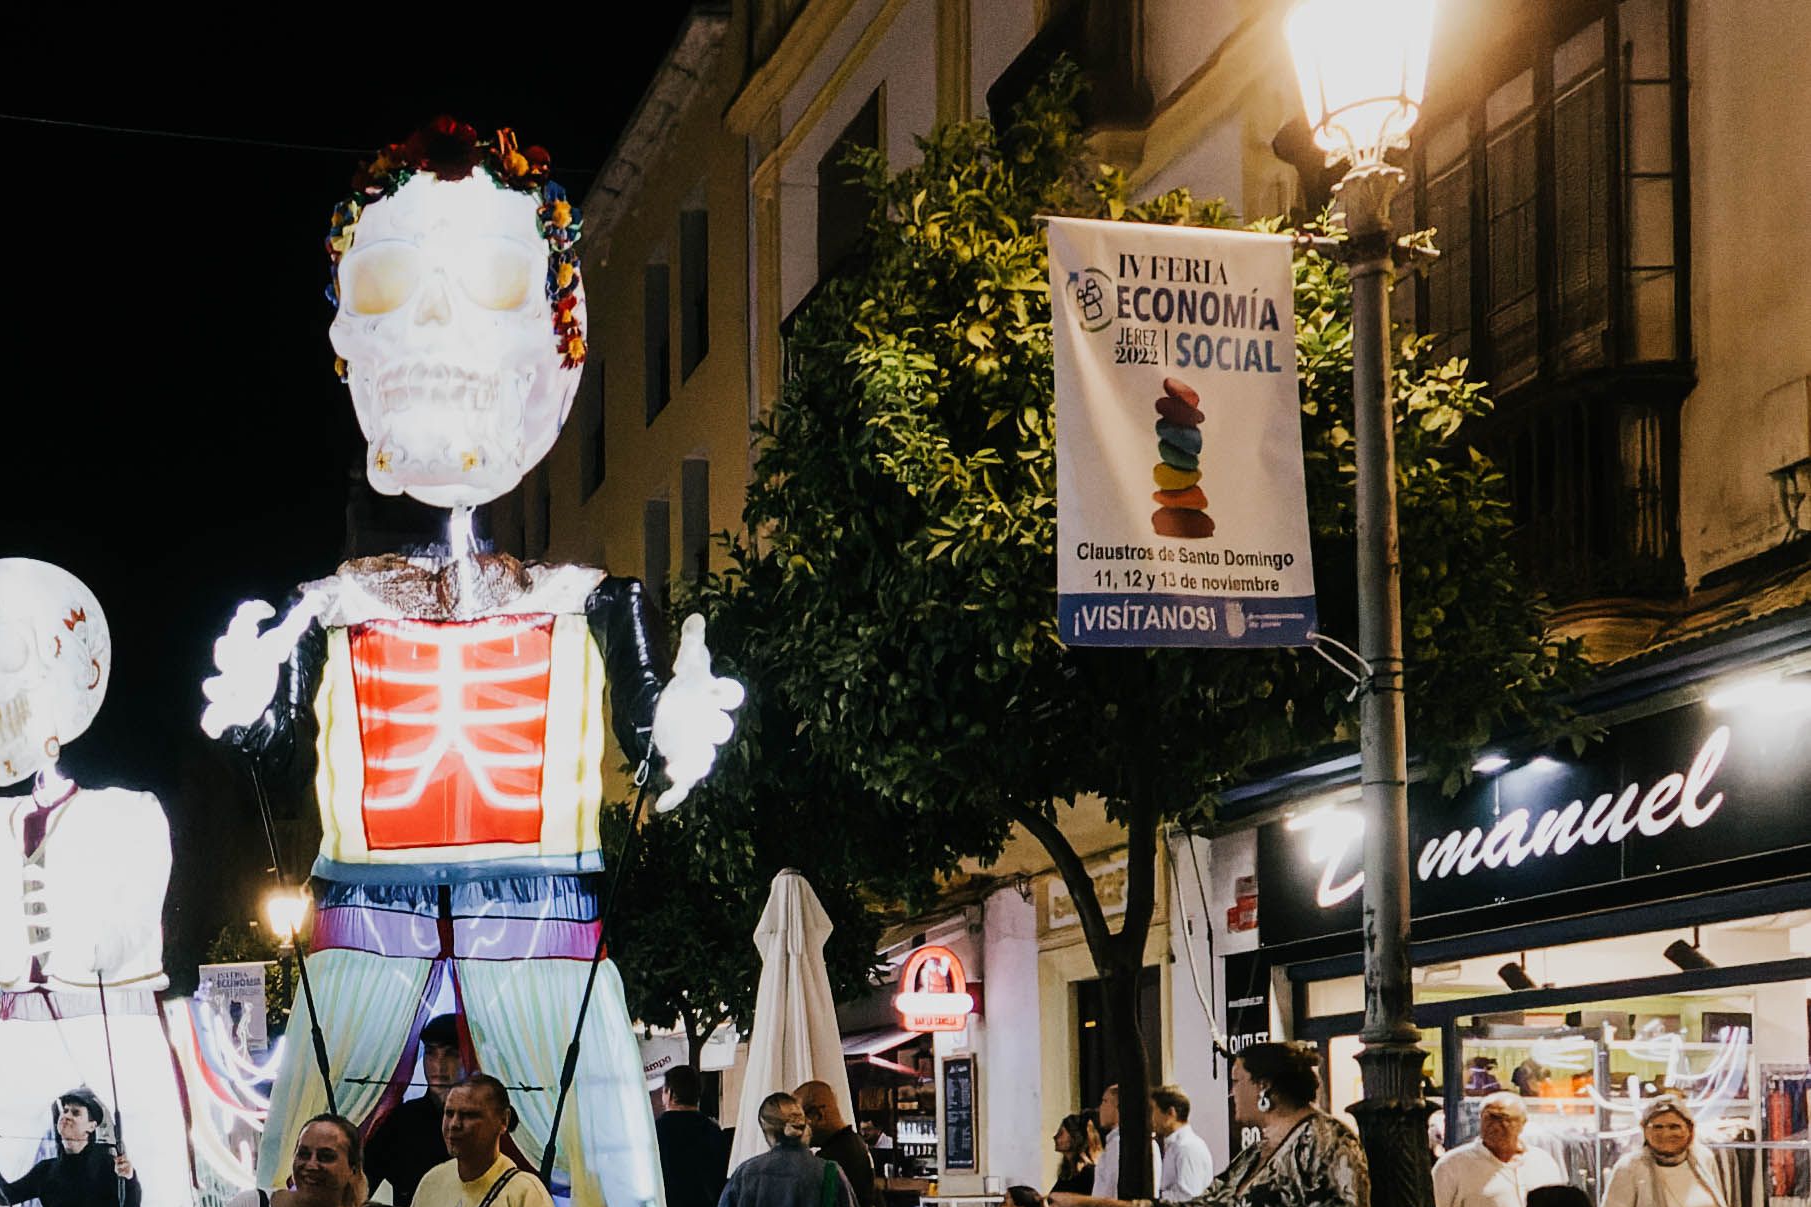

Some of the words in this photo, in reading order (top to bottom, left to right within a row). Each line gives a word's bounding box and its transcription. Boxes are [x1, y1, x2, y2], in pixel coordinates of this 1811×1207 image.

[1119, 253, 1144, 278] IV
[1151, 256, 1228, 285] FERIA
[1117, 285, 1280, 332] ECONOMÍA
[1116, 327, 1158, 347] JEREZ
[1115, 346, 1159, 365] 2022
[1176, 332, 1282, 373] SOCIAL
[1077, 542, 1154, 560] Claustros
[1158, 546, 1175, 562] de
[1179, 547, 1220, 565] Santo
[1224, 549, 1294, 571] Domingo
[1094, 569, 1118, 590] 11,
[1124, 569, 1141, 587] 12
[1146, 573, 1156, 590] y
[1160, 571, 1176, 588] 13
[1180, 573, 1197, 589] de
[1201, 575, 1279, 592] noviembre
[1074, 600, 1217, 637] ¡VISÍTANOS!
